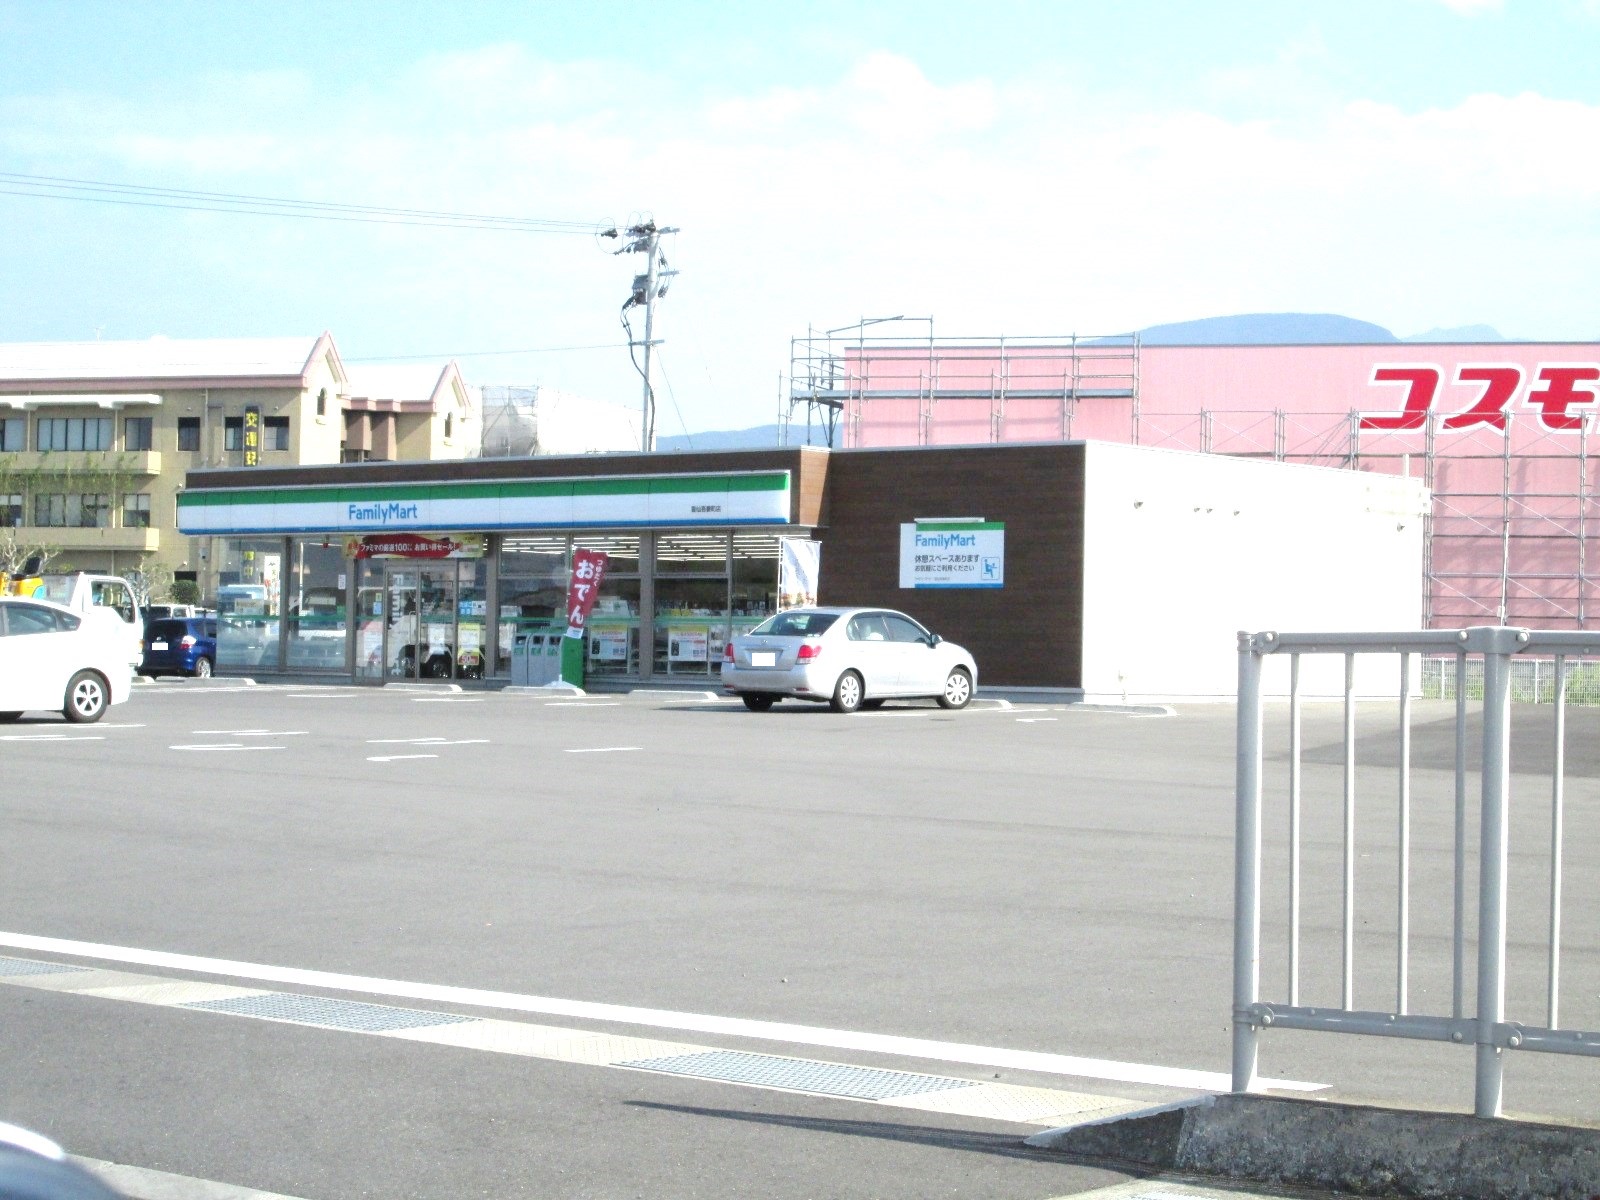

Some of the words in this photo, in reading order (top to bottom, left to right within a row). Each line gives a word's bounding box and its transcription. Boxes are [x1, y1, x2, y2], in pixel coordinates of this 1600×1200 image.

[1358, 364, 1600, 433] コスモ
[349, 503, 418, 524] FamilyMart
[915, 534, 976, 549] FamilyMart
[915, 554, 980, 564] 休憩スペースあります
[915, 564, 975, 572] お気軽にご利用ください
[570, 559, 594, 625] おでん
